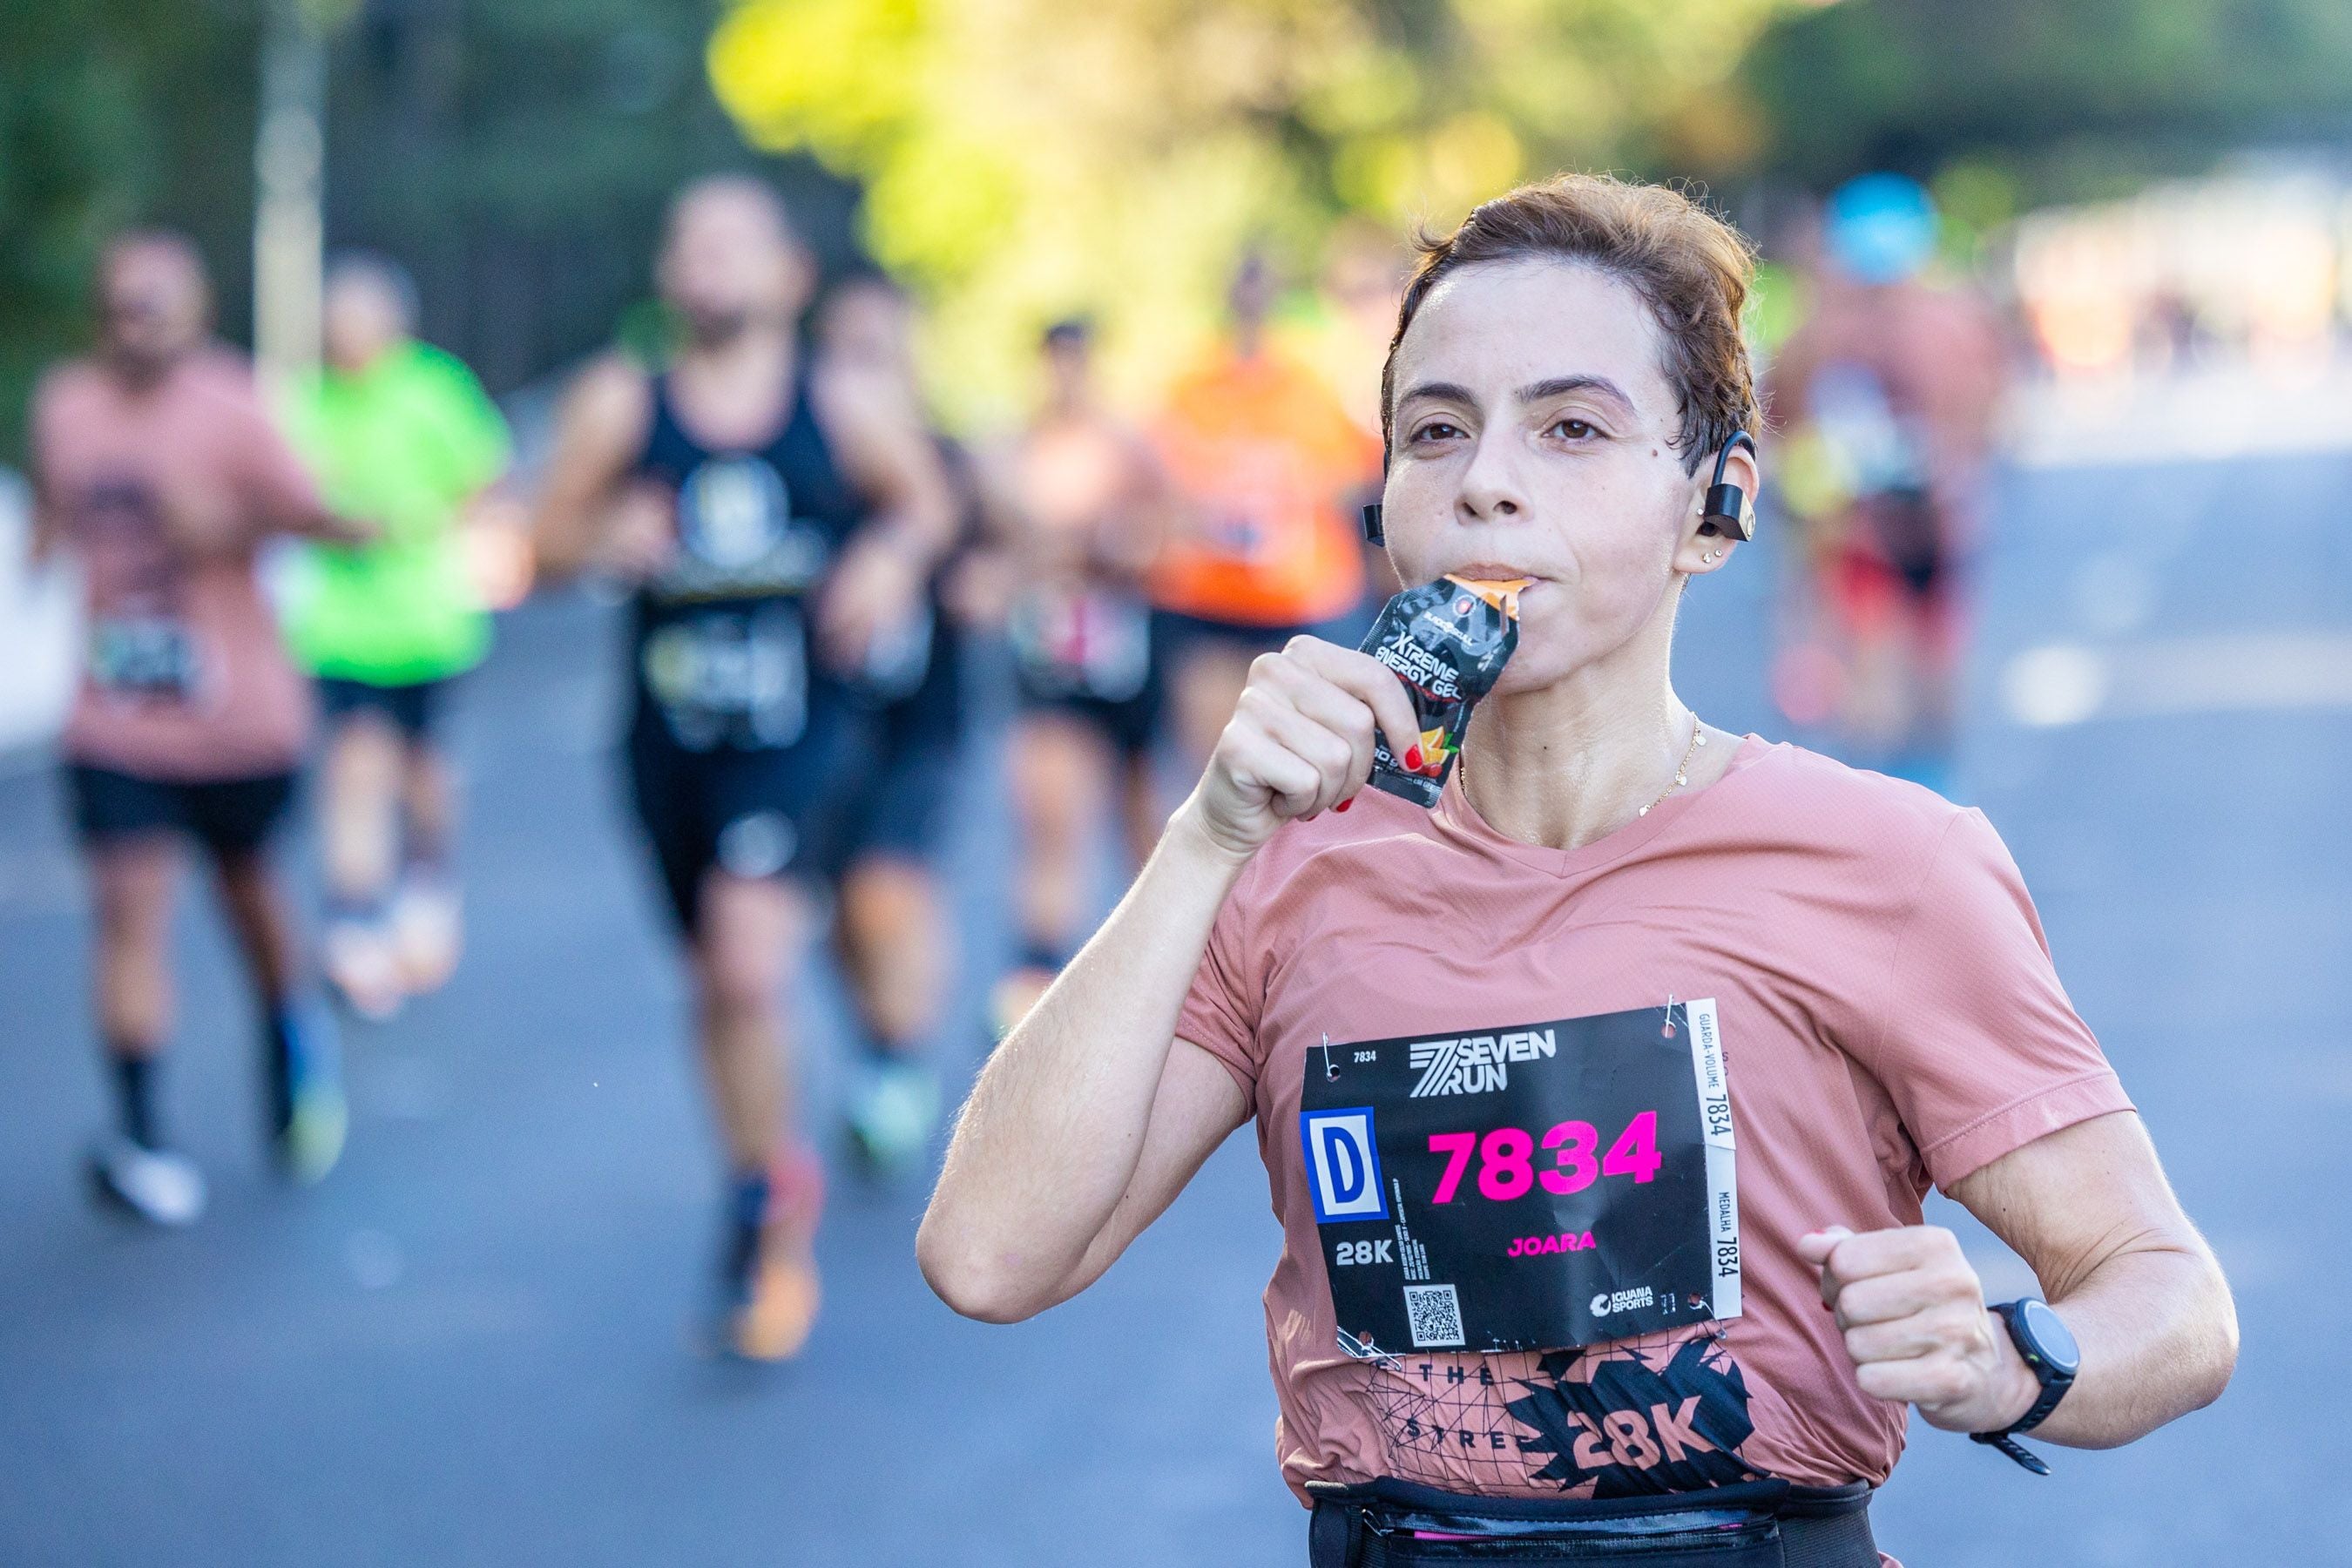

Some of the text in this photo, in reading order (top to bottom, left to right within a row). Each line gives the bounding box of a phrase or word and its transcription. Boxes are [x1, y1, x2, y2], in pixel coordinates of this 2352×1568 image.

[1375, 646, 1462, 700] ENERGY GEL
[1389, 631, 1459, 682] XTREME
[1354, 1051, 1376, 1063] 7834
[1456, 1029, 1557, 1067] SEVEN
[1441, 1063, 1508, 1097] RUN
[1699, 1013, 1732, 1137] GUARDA-VOLUME 7834
[1322, 1126, 1365, 1204] D
[1428, 1111, 1662, 1204] 7834
[1335, 1240, 1394, 1266] 28K
[1507, 1232, 1597, 1258] JOARA
[1717, 1192, 1739, 1278] MEDALHA 7834
[1612, 1286, 1652, 1303] IGUANA
[1612, 1296, 1653, 1313] SPORTS
[1419, 1364, 1495, 1386] THE
[1567, 1396, 1723, 1470] 28K
